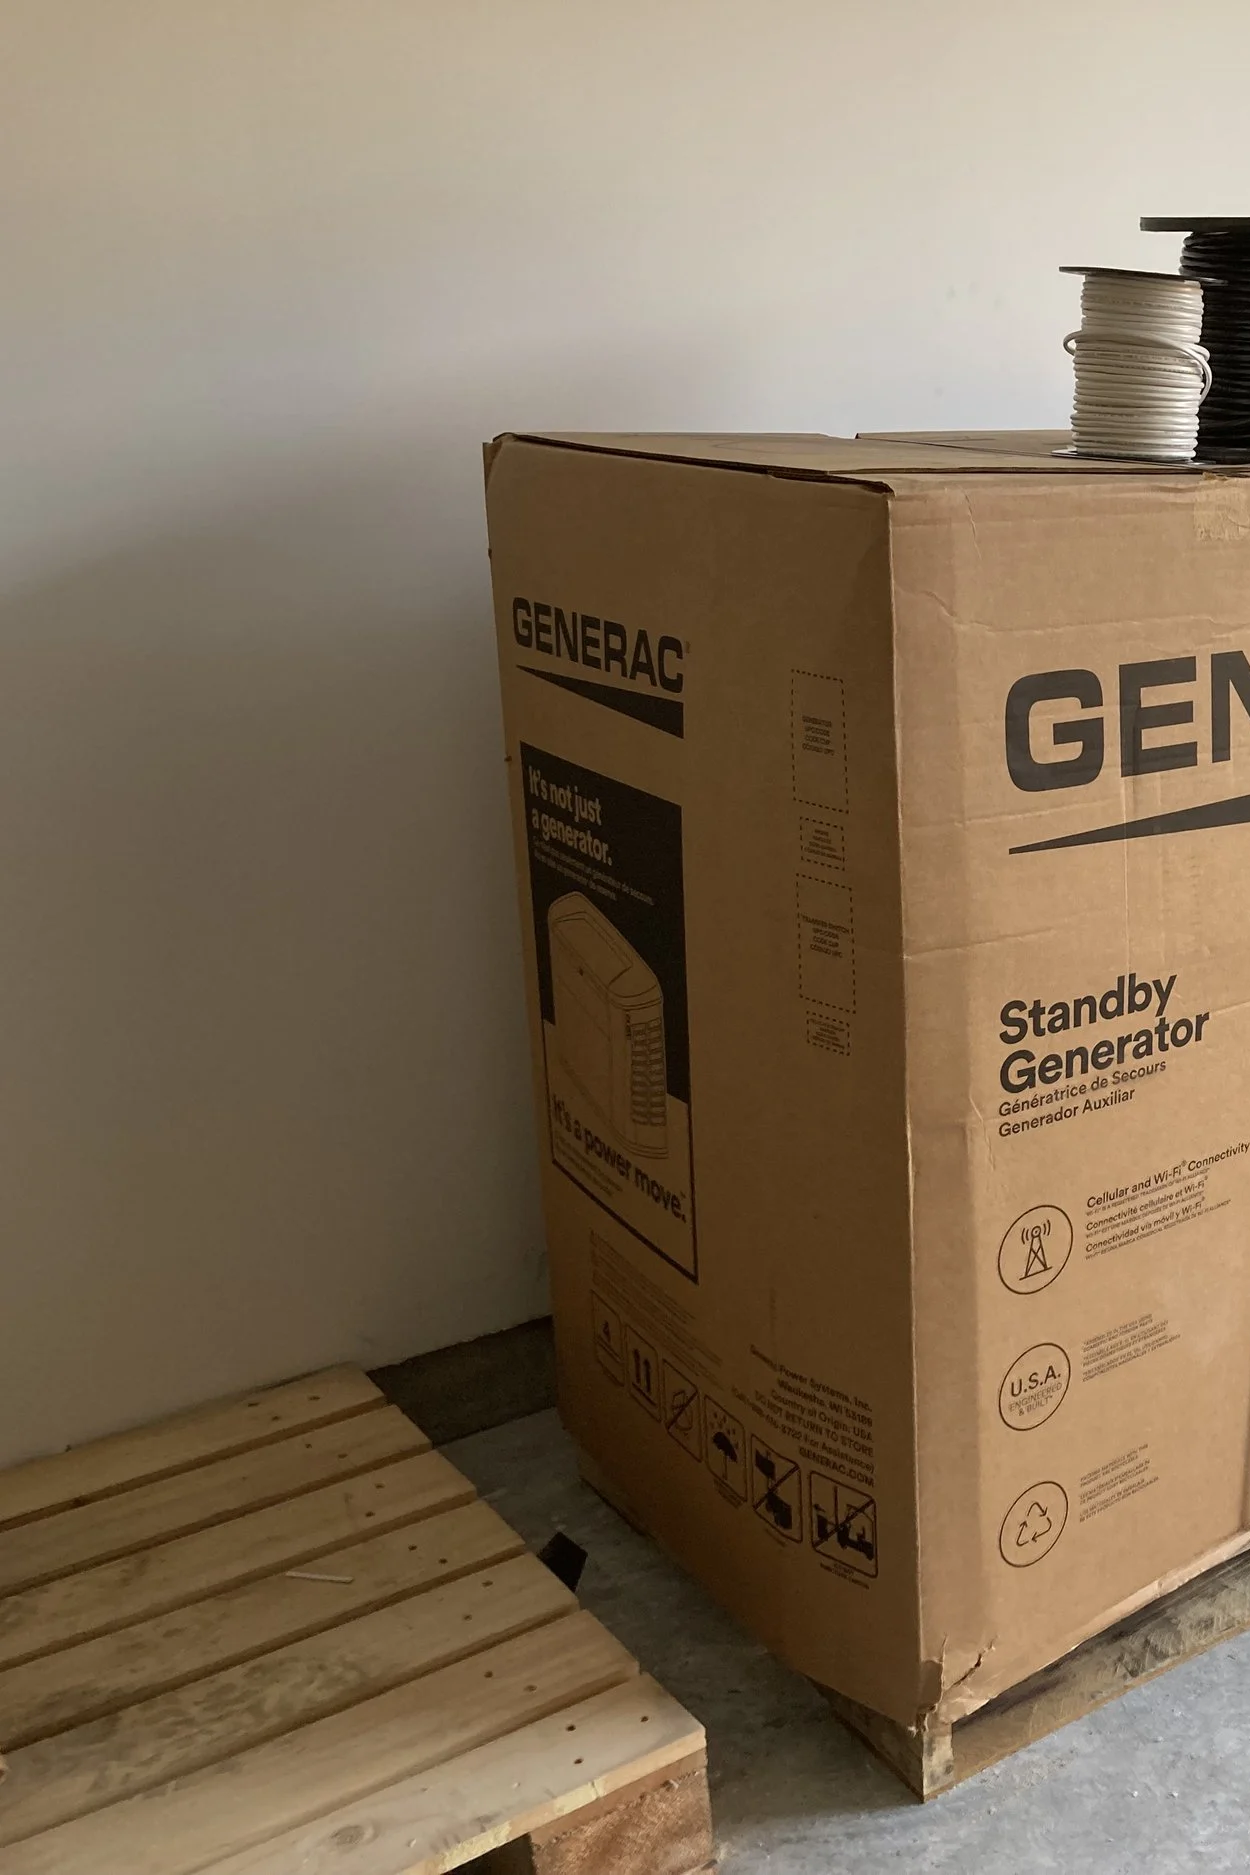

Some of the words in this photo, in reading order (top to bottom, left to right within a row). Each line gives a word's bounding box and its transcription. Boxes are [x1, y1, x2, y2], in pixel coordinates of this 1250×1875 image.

[513, 597, 684, 695] GENERAC
[528, 765, 548, 801] It's
[550, 782, 573, 812] not
[574, 785, 602, 826] just
[531, 807, 540, 830] a
[541, 813, 613, 866] generator.
[999, 971, 1177, 1045] Standby
[999, 1010, 1210, 1095] Generator
[998, 1083, 1087, 1118] Génératrice
[1089, 1076, 1109, 1092] de
[1111, 1059, 1167, 1087] Secours
[998, 1103, 1080, 1139] Generador
[1081, 1086, 1136, 1115] Auxiliar
[552, 1093, 573, 1134] It's
[573, 1119, 582, 1142] a
[583, 1127, 633, 1182] power
[1086, 1185, 1129, 1209] Cellular
[1131, 1176, 1152, 1194] and
[1188, 1141, 1250, 1172] Connectivity
[1085, 1225, 1140, 1253] Conectividad
[1153, 1212, 1175, 1228] móvil
[1086, 1207, 1138, 1232] Connectivité
[1139, 1192, 1174, 1215] cellulaire
[1174, 1189, 1183, 1199] et
[1008, 1382, 1063, 1413] ENGINEERED
[1010, 1364, 1062, 1398] U.S.A.
